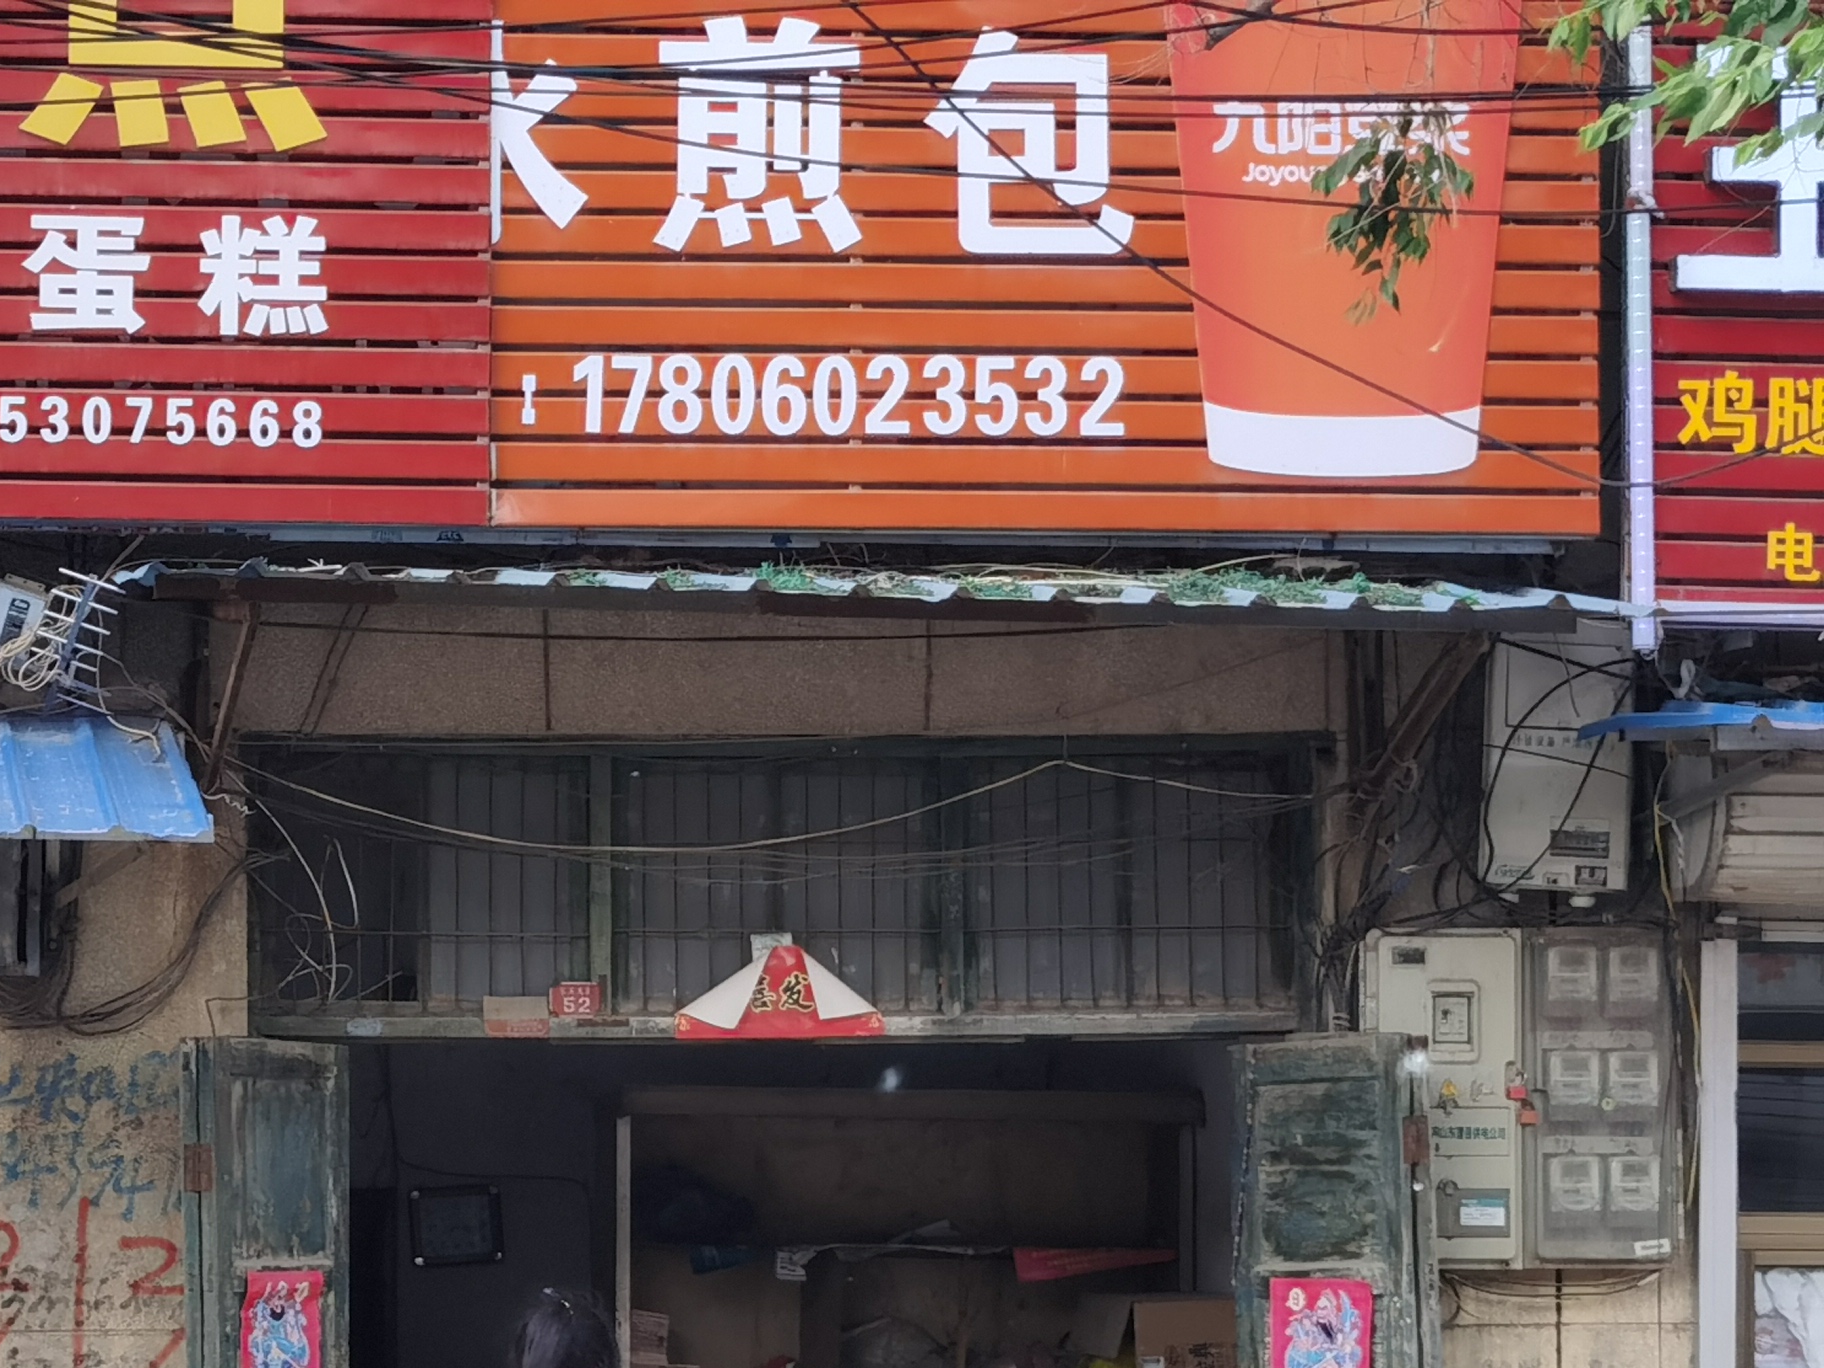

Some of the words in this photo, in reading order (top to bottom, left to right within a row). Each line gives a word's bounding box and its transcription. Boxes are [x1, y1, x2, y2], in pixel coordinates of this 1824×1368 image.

[23, 213, 328, 336] 蛋糕
[1677, 370, 1824, 455] 鸡腿
[1766, 521, 1822, 583] 电
[563, 996, 591, 1013] 52
